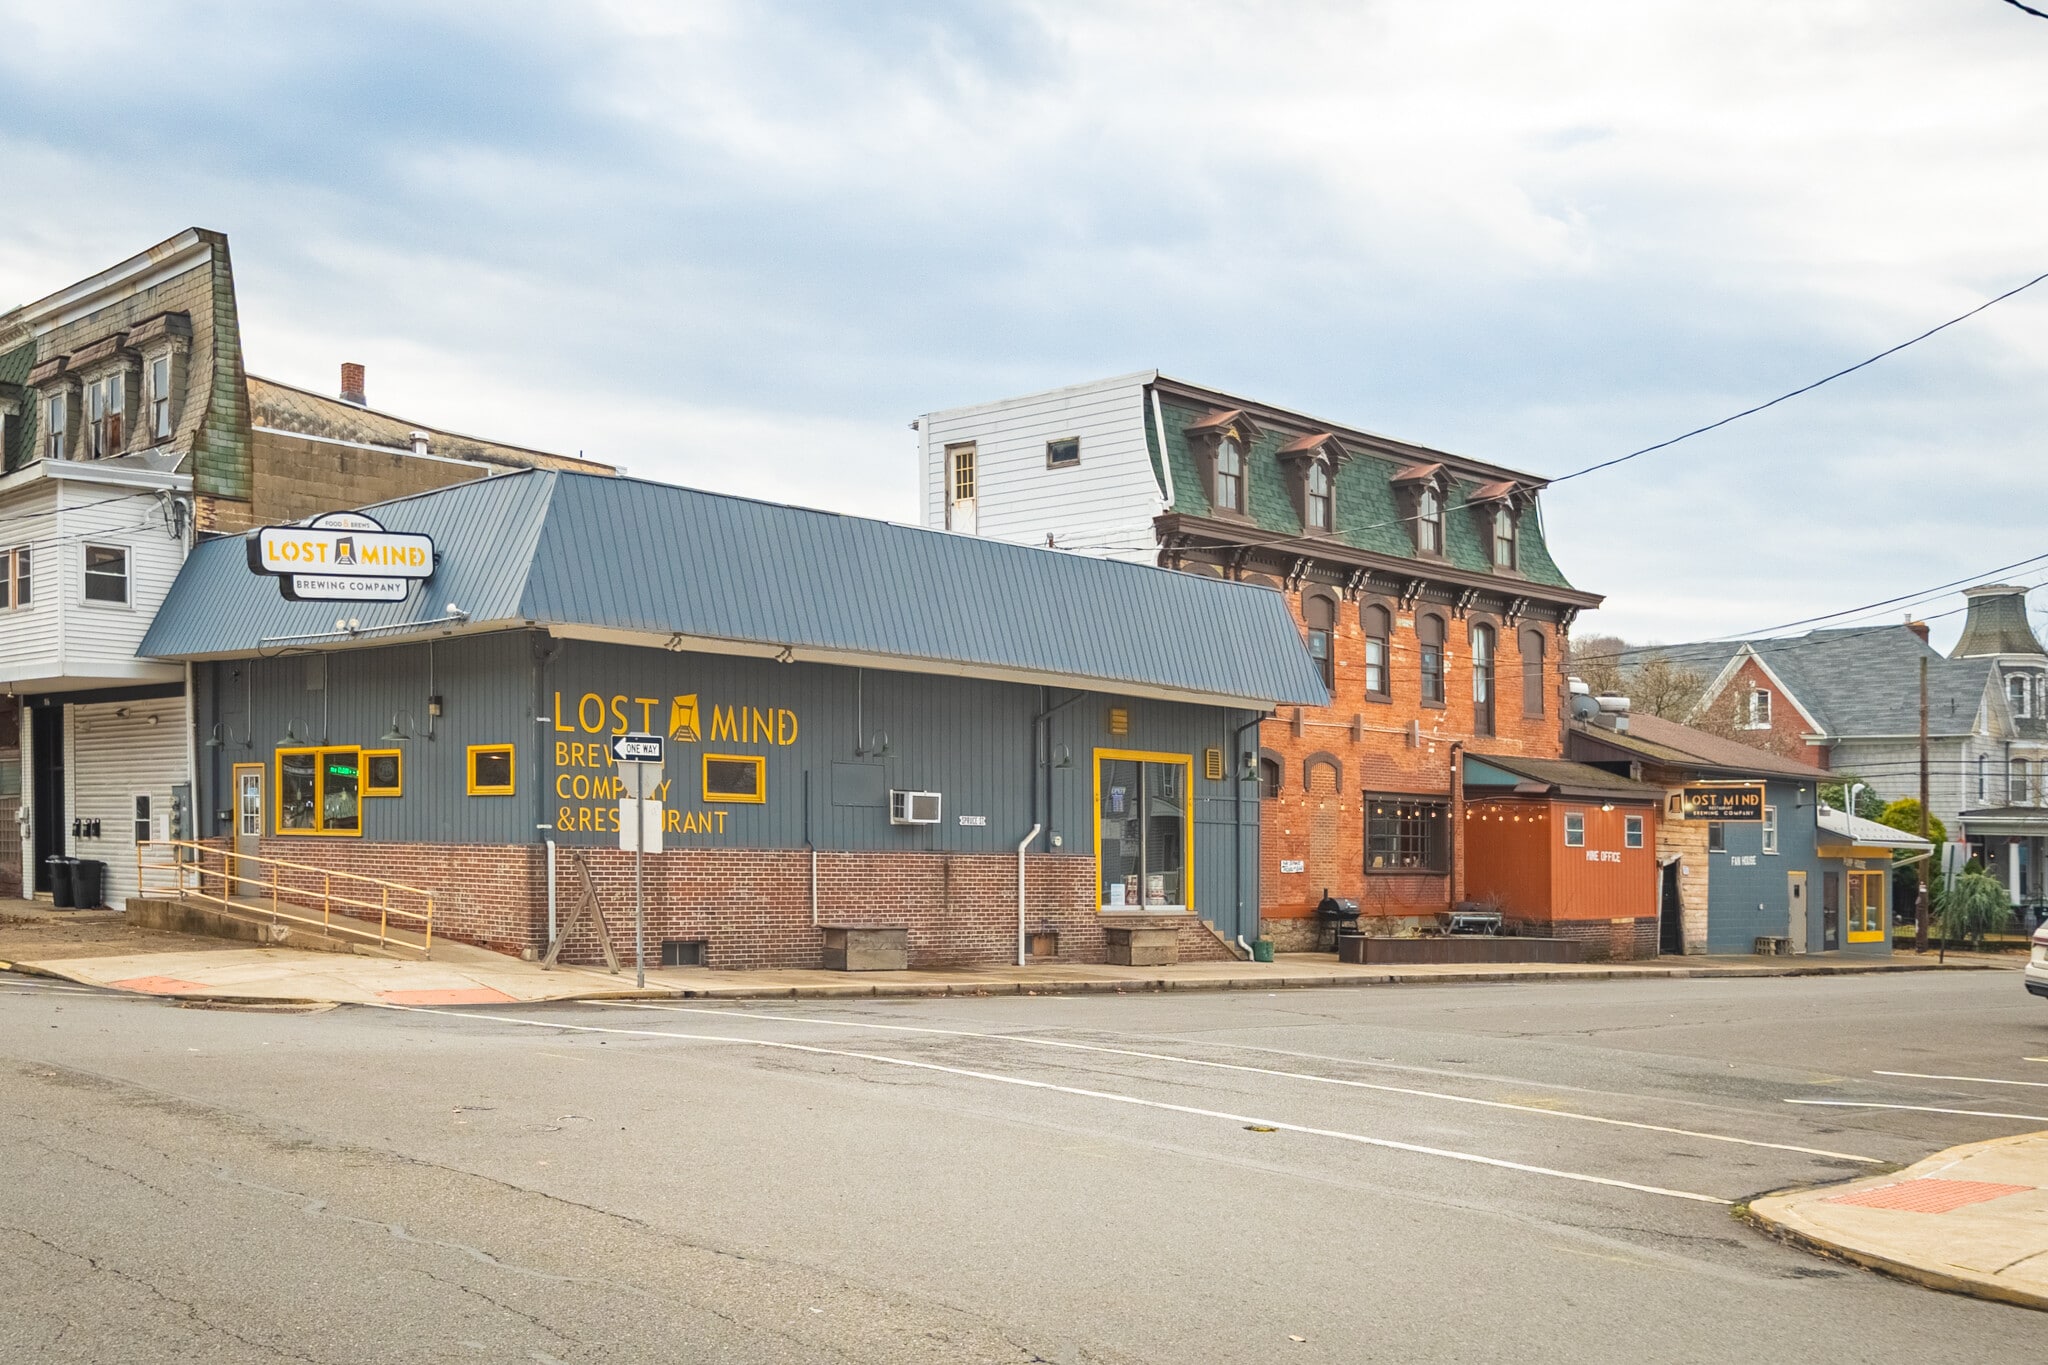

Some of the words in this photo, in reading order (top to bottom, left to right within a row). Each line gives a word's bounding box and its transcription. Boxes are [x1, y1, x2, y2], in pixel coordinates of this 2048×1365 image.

[268, 540, 328, 563] LOST
[361, 545, 426, 567] MIND
[296, 580, 345, 590] BREWING
[350, 581, 401, 592] COMPANY
[555, 691, 659, 735] LOST
[710, 703, 799, 746] MIND
[626, 743, 640, 753] ONE
[643, 744, 657, 753] WAY
[555, 774, 672, 802] COMPY
[1685, 794, 1717, 806] LOST
[1723, 794, 1759, 806] MIND
